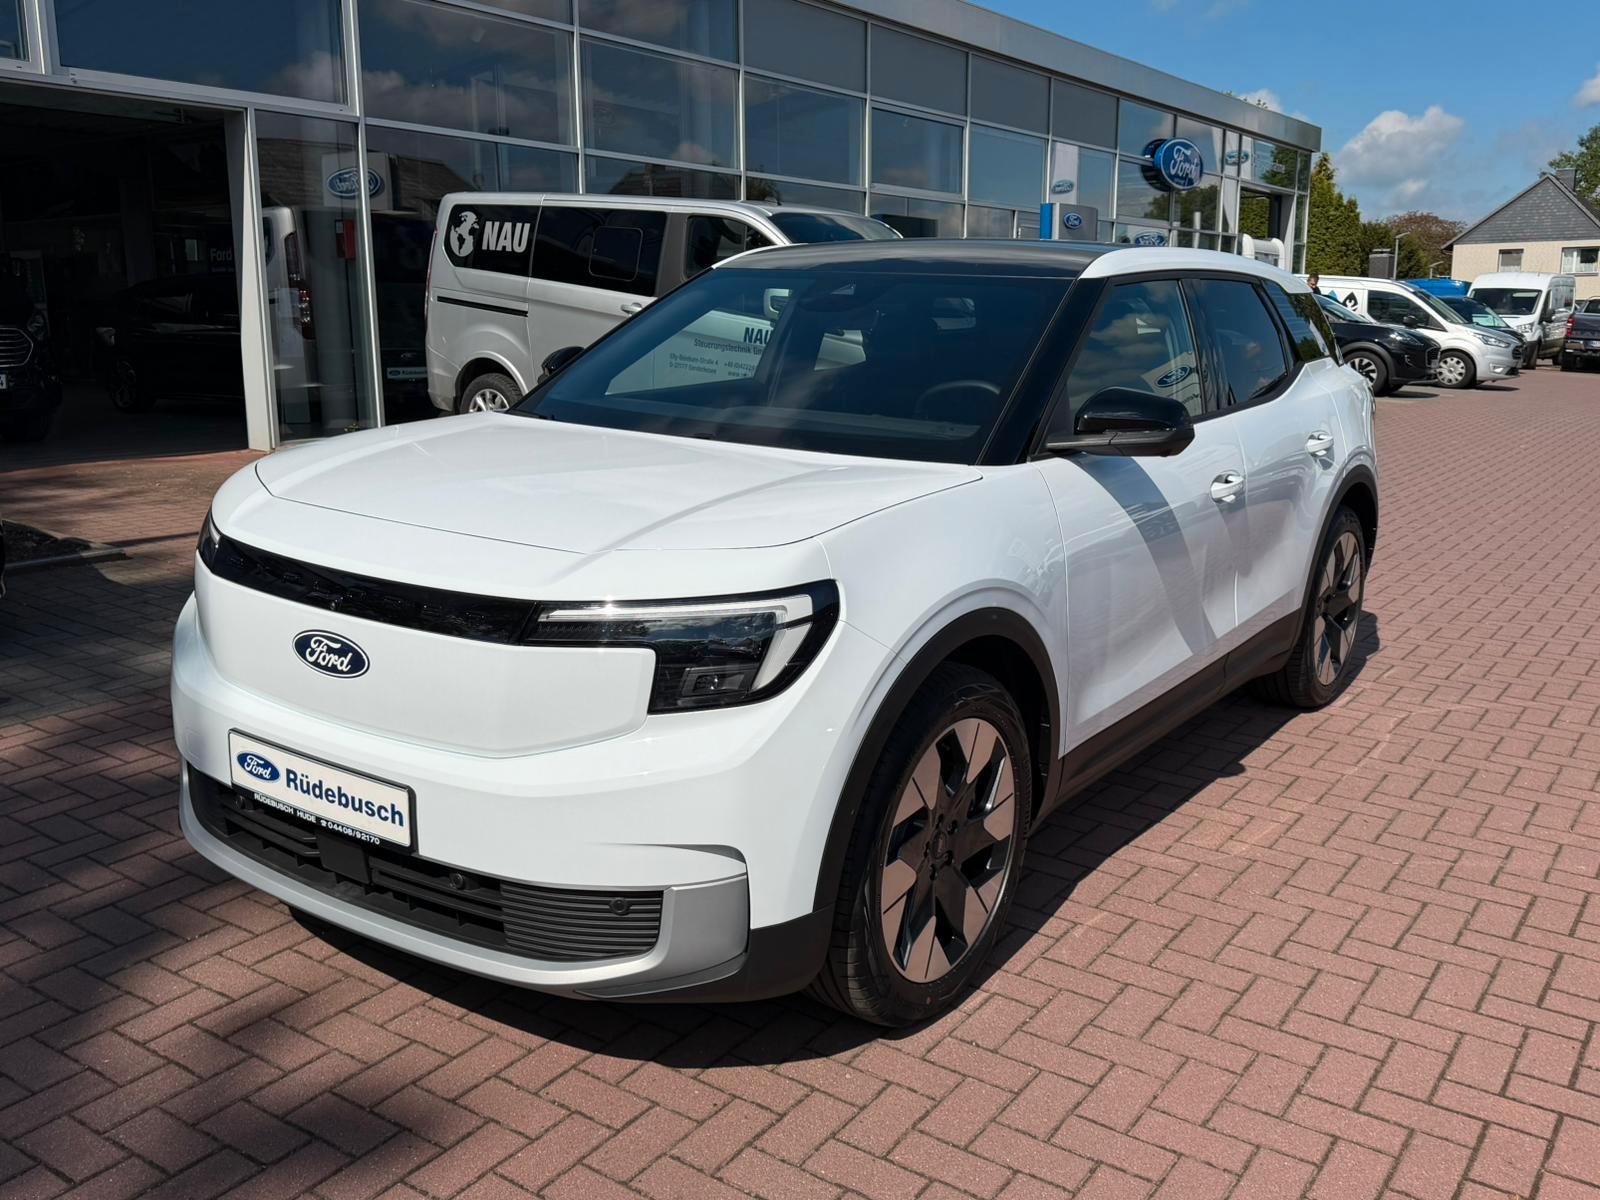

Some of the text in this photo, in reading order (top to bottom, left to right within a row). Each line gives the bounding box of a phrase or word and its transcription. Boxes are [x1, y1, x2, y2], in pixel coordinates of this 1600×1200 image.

[1169, 145, 1198, 179] Ford
[481, 221, 531, 253] NAU
[305, 636, 352, 672] Ford
[244, 755, 404, 827] Ford Rüdebusch
[254, 792, 294, 815] RÜDEBUSCH
[296, 811, 317, 824] HUDE
